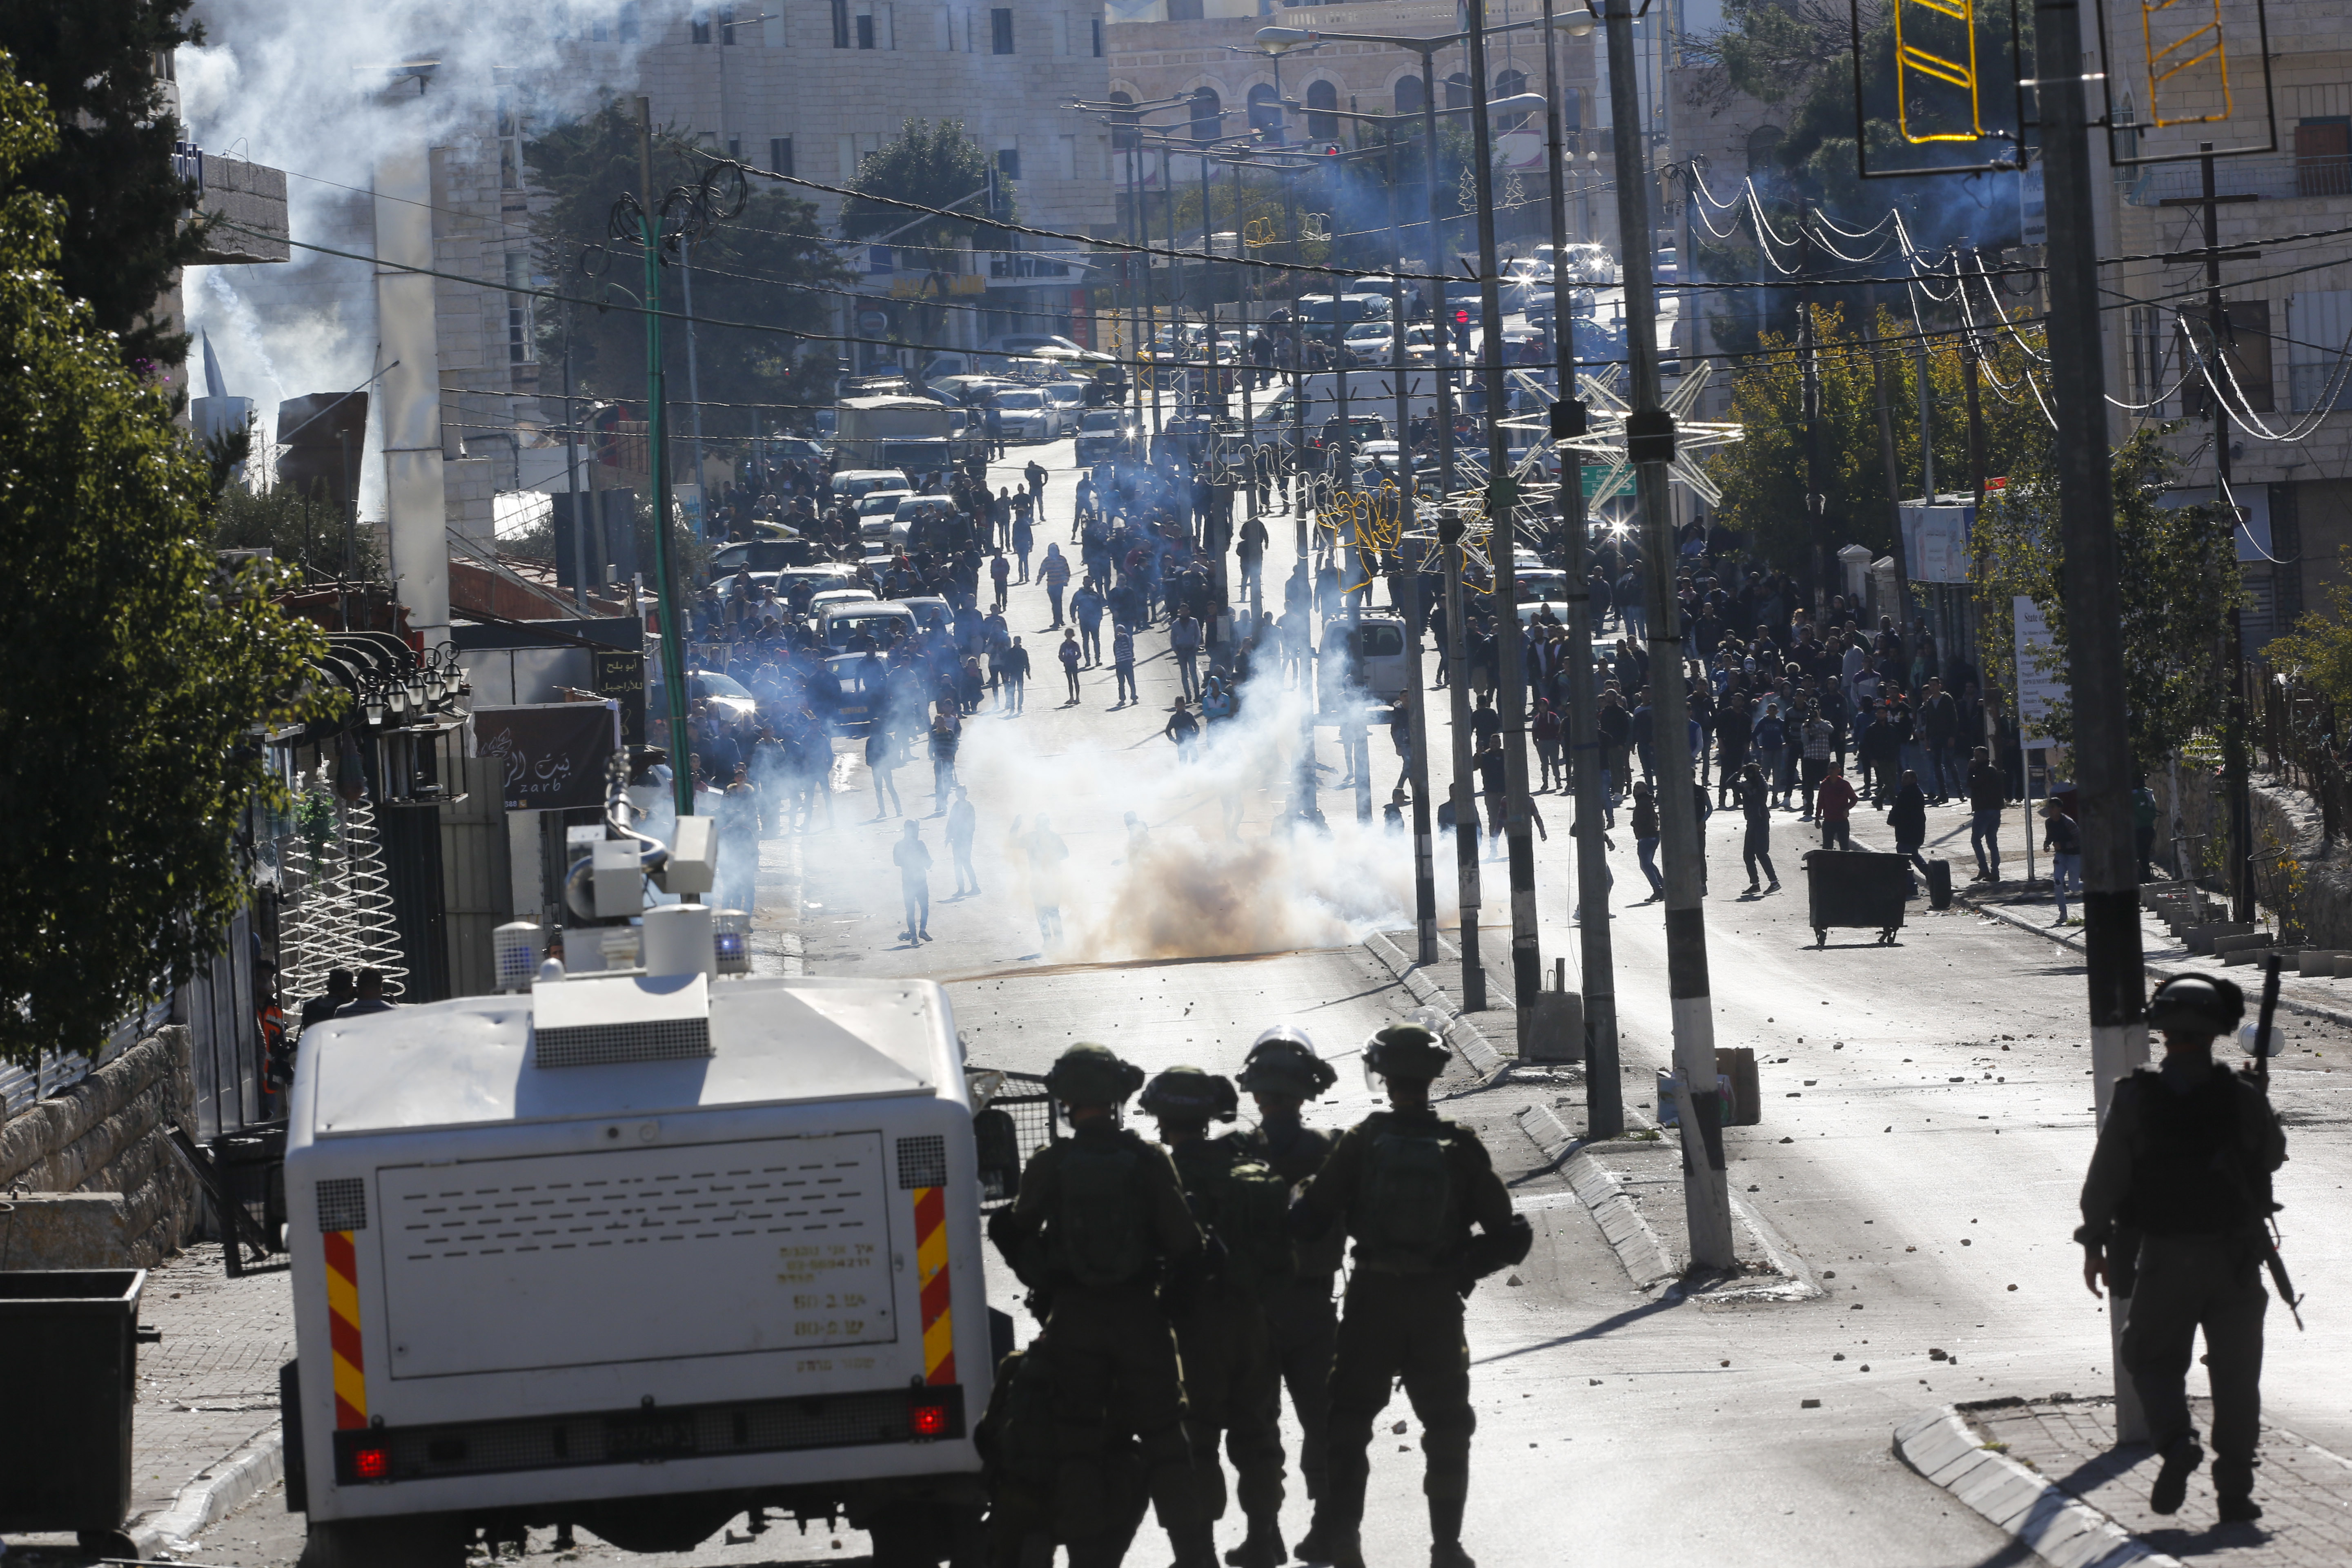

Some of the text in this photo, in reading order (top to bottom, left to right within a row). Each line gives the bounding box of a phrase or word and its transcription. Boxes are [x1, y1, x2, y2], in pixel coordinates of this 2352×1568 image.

[2024, 612, 2038, 623] State
[606, 658, 637, 673] أبو بلح
[601, 679, 643, 692] للأراجيل
[520, 778, 561, 793] zarb
